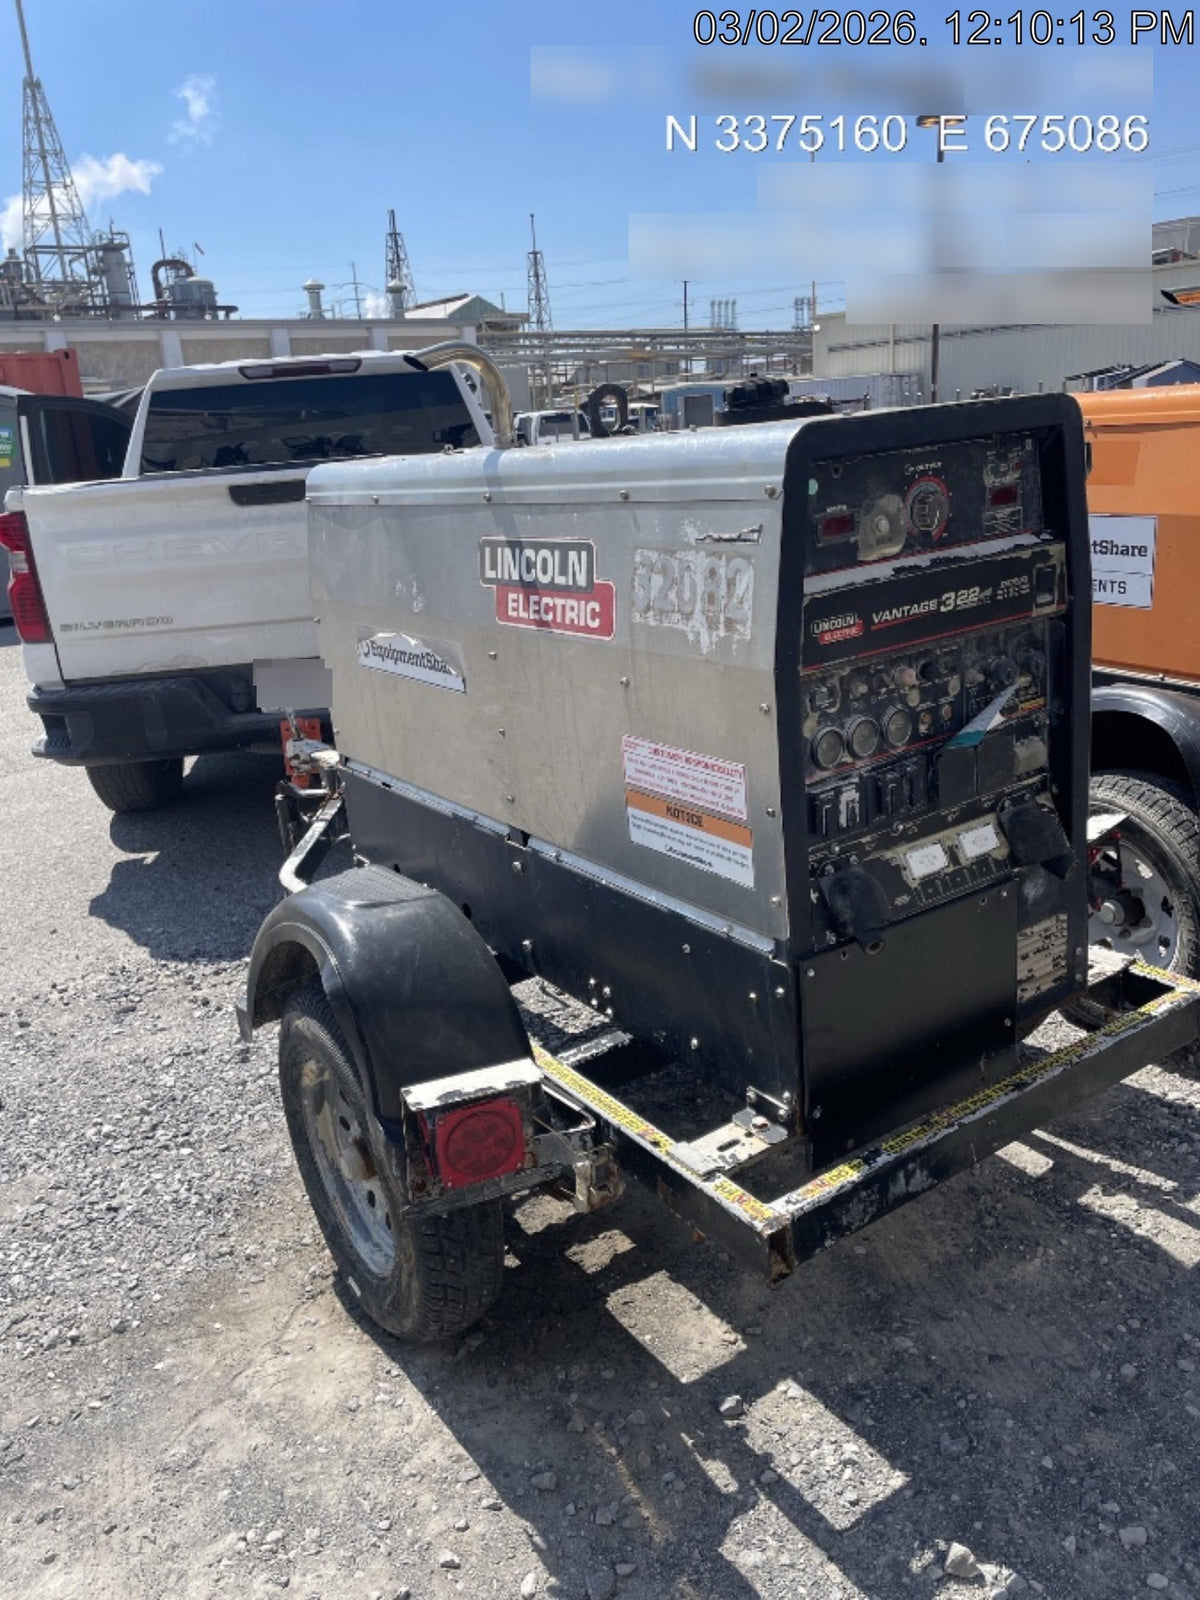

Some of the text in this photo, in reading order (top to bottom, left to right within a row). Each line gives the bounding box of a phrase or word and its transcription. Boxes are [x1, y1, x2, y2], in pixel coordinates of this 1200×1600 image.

[484, 546, 588, 588] LINCOLN
[507, 591, 600, 628] ELECTRIC
[872, 599, 939, 625] VANTAGE
[940, 586, 981, 612] 322
[665, 805, 704, 828] NOTICE
